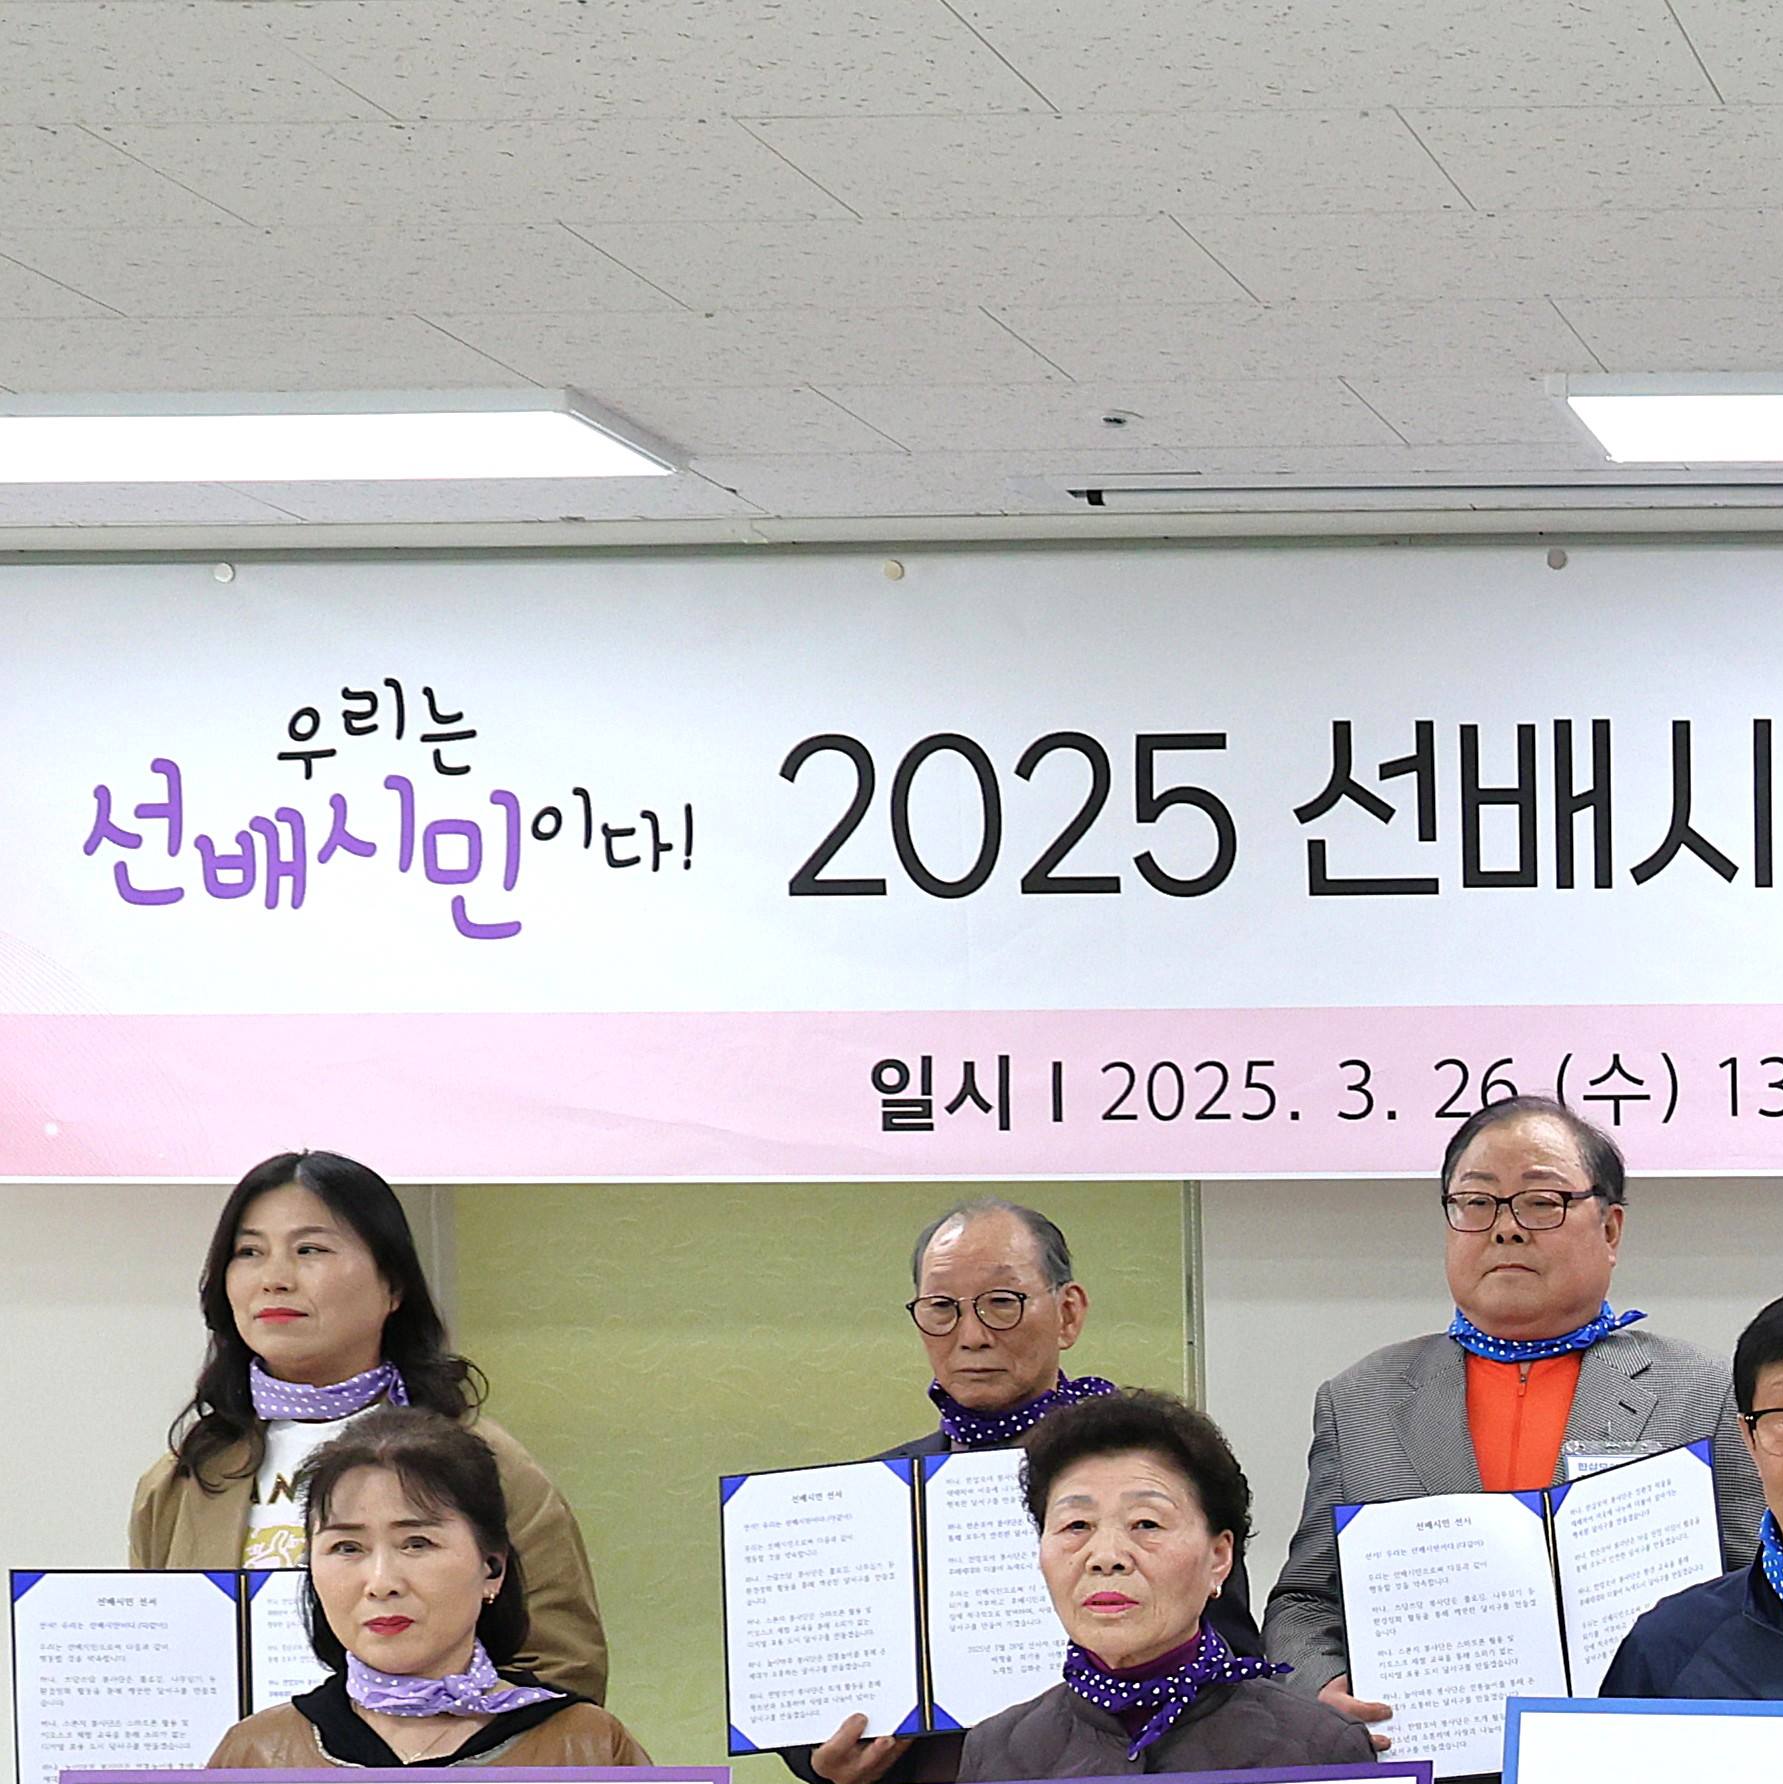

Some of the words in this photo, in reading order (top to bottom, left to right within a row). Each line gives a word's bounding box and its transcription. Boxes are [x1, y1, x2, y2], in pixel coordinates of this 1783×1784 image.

[277, 678, 477, 780] 우리는
[83, 749, 693, 939] 선배시민이다!
[780, 732, 1236, 899] 2025
[872, 1055, 1010, 1131] 일시
[1102, 1061, 1299, 1121] 2025.
[1338, 1060, 1396, 1120] 3.
[1431, 1055, 1521, 1123] 26
[1554, 1053, 1680, 1128] (수)
